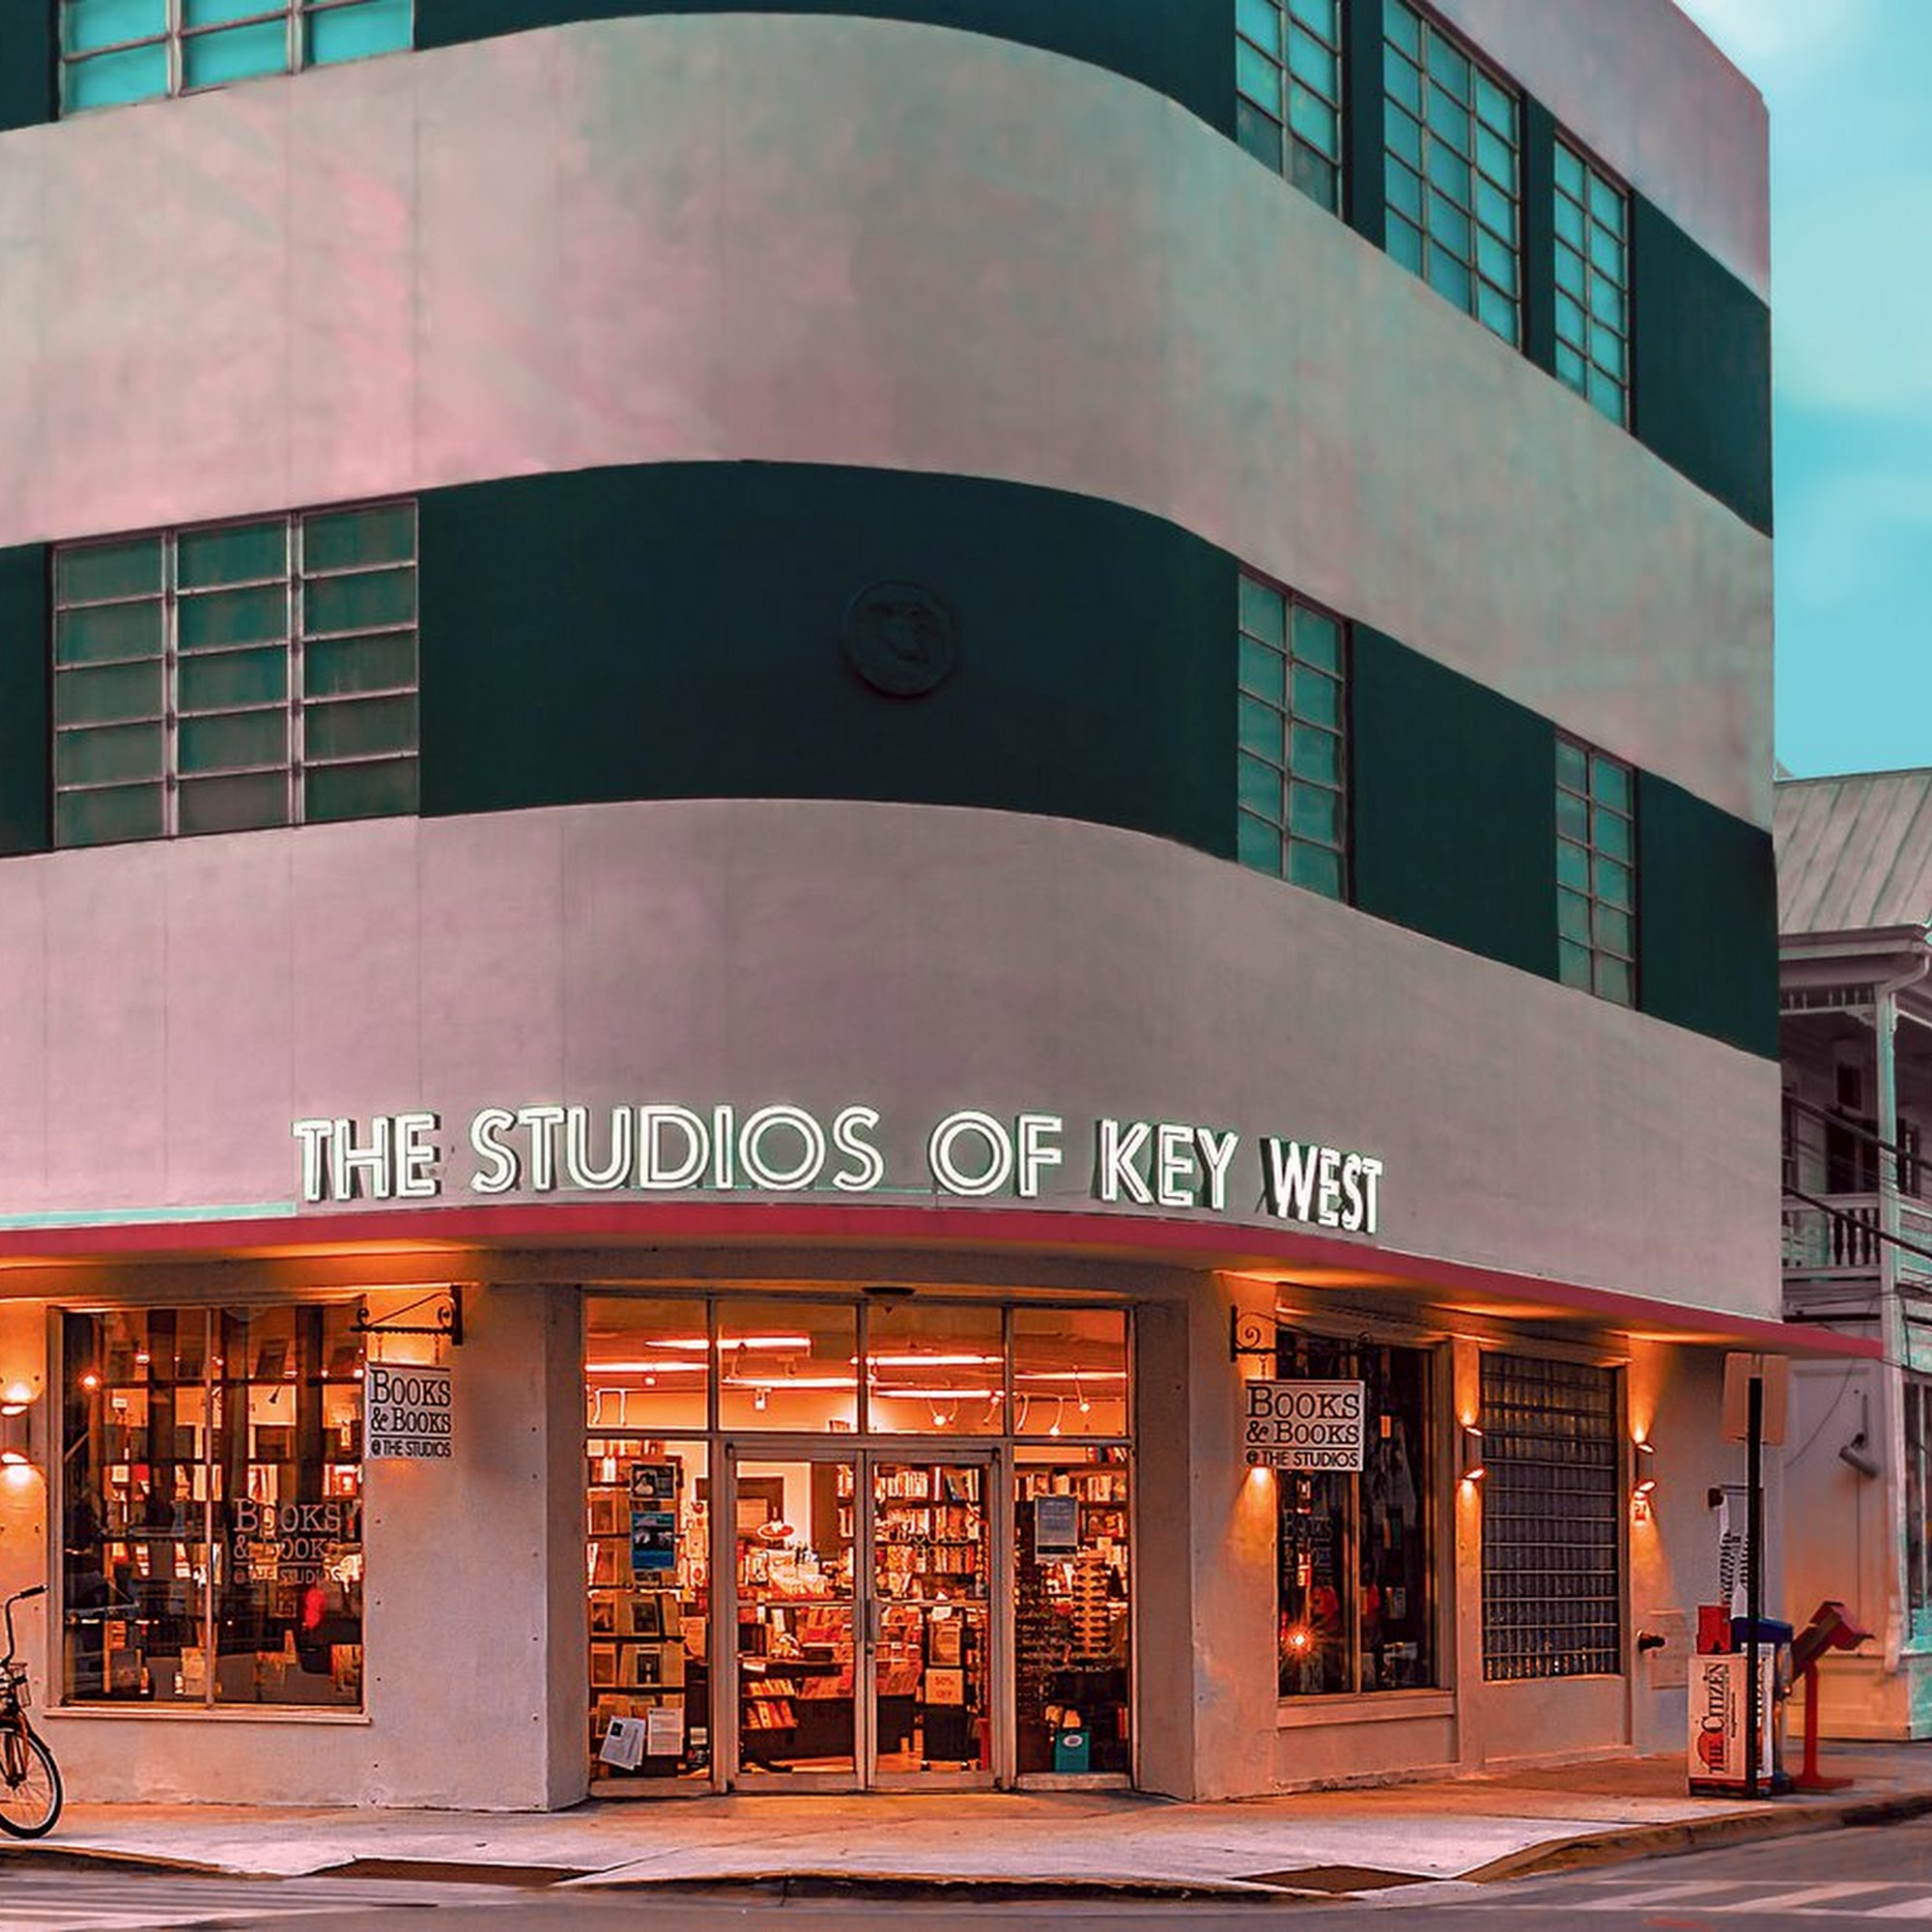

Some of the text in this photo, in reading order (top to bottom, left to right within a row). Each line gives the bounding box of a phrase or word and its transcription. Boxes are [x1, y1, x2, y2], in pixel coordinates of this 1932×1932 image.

[293, 1104, 1383, 1235] THE STUDIOS OF KEY WEST
[369, 1369, 451, 1407] BOOKS
[1245, 1386, 1360, 1419] BOOKS
[371, 1406, 452, 1434] & BOOKS
[1246, 1420, 1360, 1444] & BOOKS
[406, 1441, 452, 1458] STUDIOS
[1261, 1451, 1290, 1466] THE
[1293, 1452, 1359, 1467] STUDIOS
